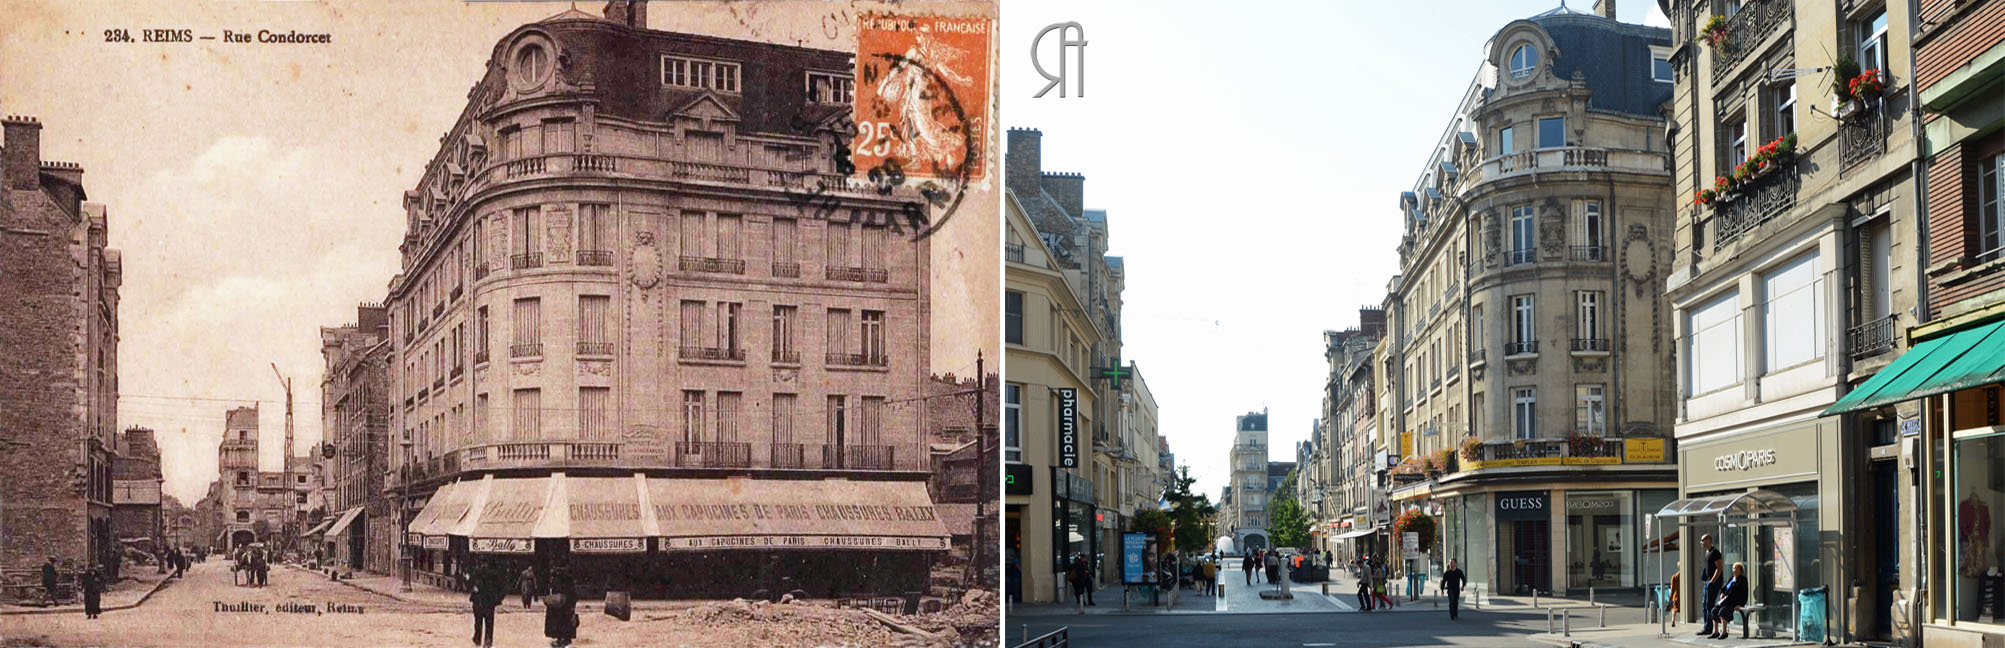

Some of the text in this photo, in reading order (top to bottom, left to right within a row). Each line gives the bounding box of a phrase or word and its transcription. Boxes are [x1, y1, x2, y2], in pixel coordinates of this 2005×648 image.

[1060, 389, 1076, 467] pharmacie
[1713, 449, 1776, 471] COSMOPARIS
[1500, 497, 1542, 510] GUESS
[655, 504, 677, 521] AUX
[681, 503, 749, 521] CAPUCINES
[753, 504, 773, 520] DE
[775, 504, 810, 521] PARIS
[815, 504, 893, 521] CHAUSSURES
[584, 539, 635, 550] CHAUSSURES
[688, 538, 703, 547] AUX
[711, 537, 756, 547] CAPUCINES
[763, 537, 774, 546] DE
[783, 536, 806, 546] PARIS
[823, 536, 883, 547] CHAUSSURES
